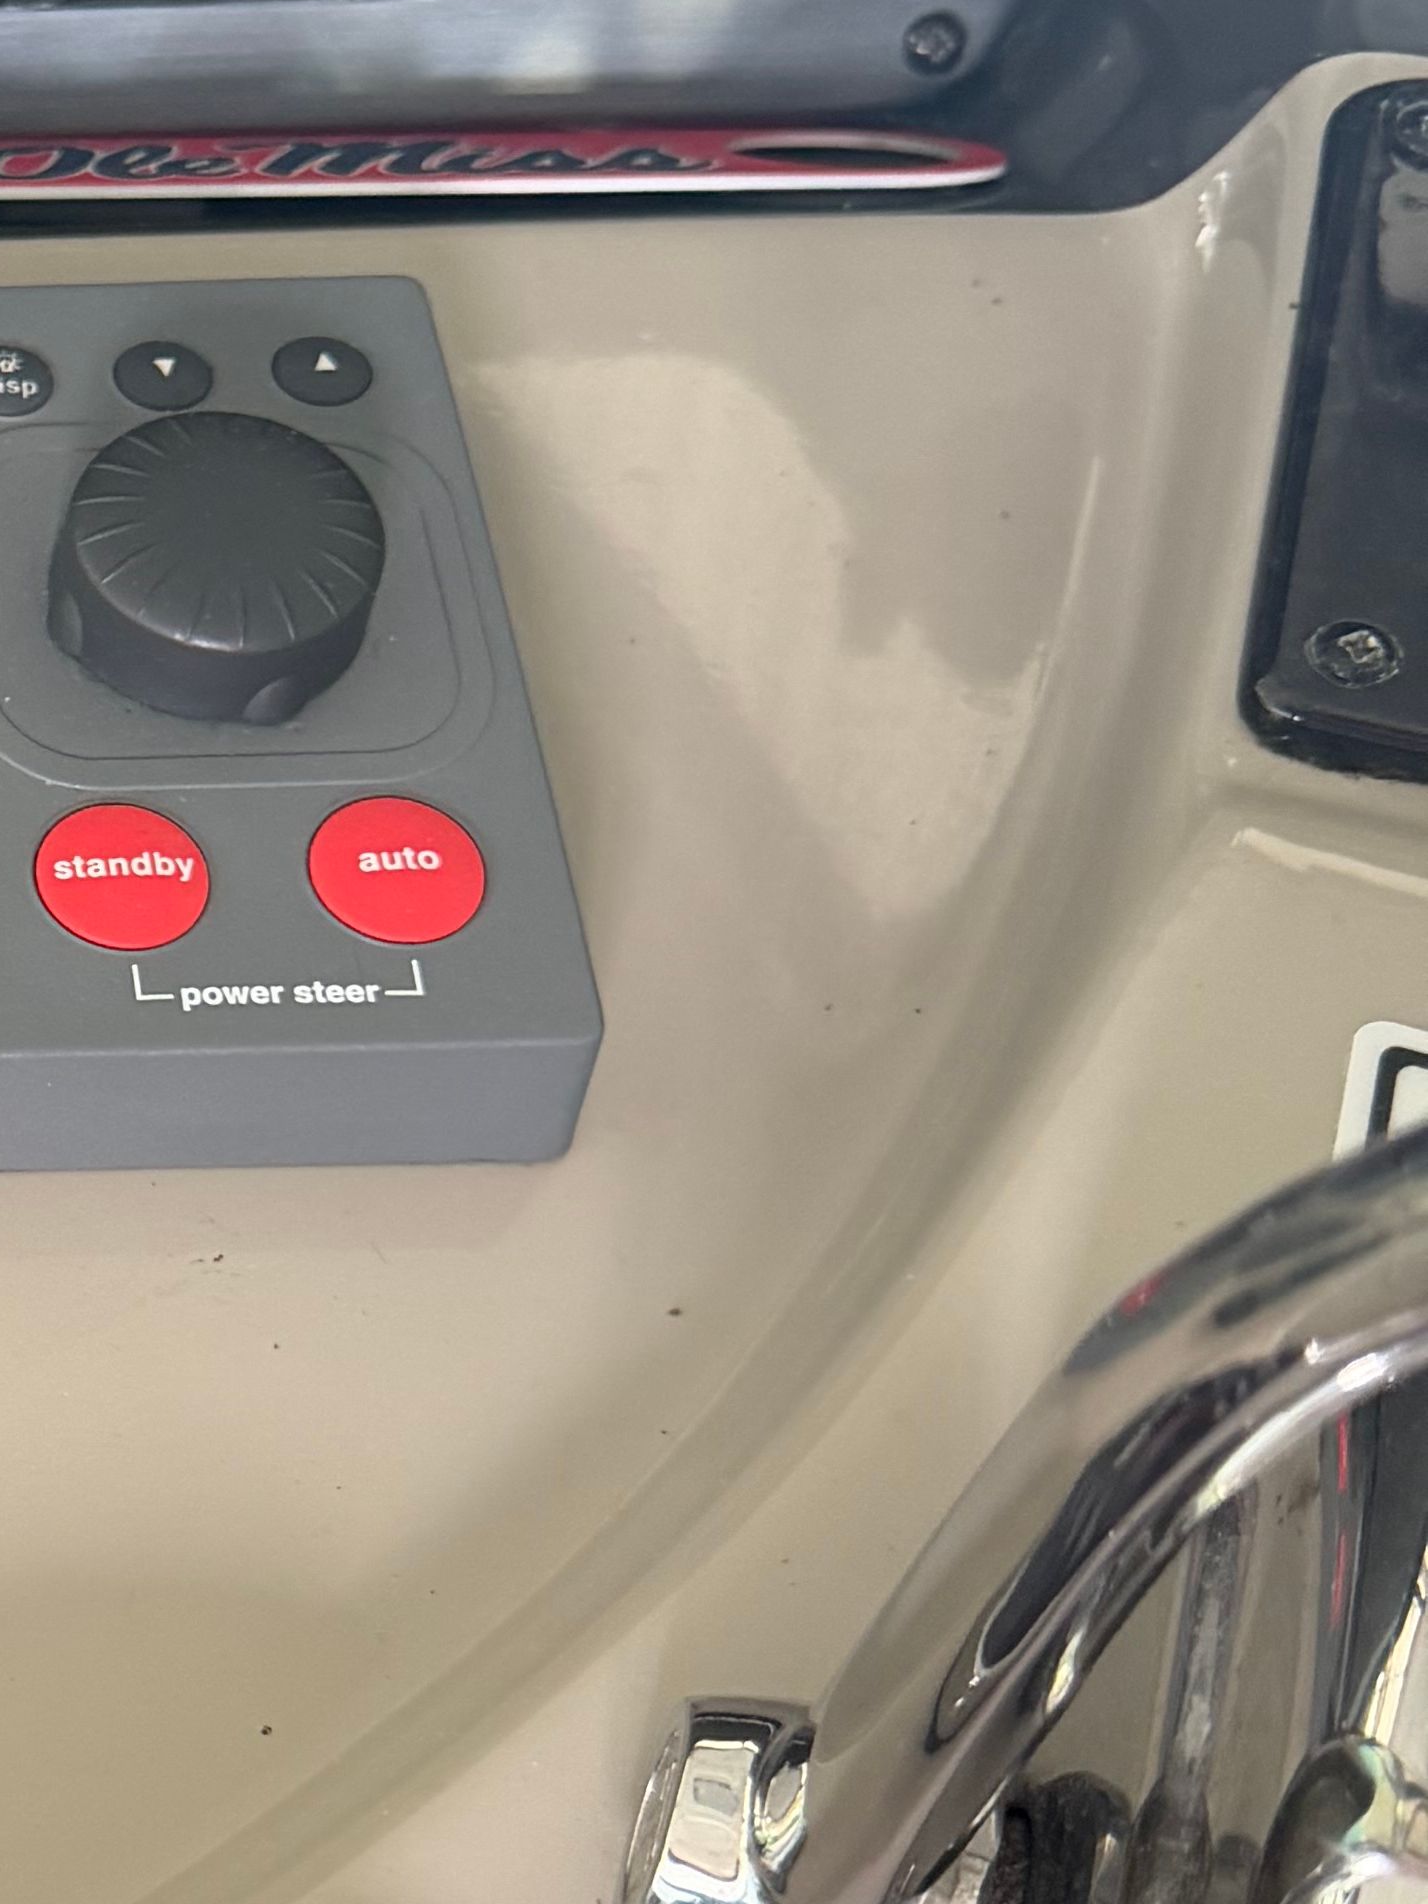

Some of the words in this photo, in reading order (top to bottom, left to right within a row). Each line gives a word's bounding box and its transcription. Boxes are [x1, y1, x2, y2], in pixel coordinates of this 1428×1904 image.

[53, 852, 195, 882] standby
[358, 844, 440, 873] auto
[180, 981, 284, 1010] power
[294, 977, 380, 1004] steer
